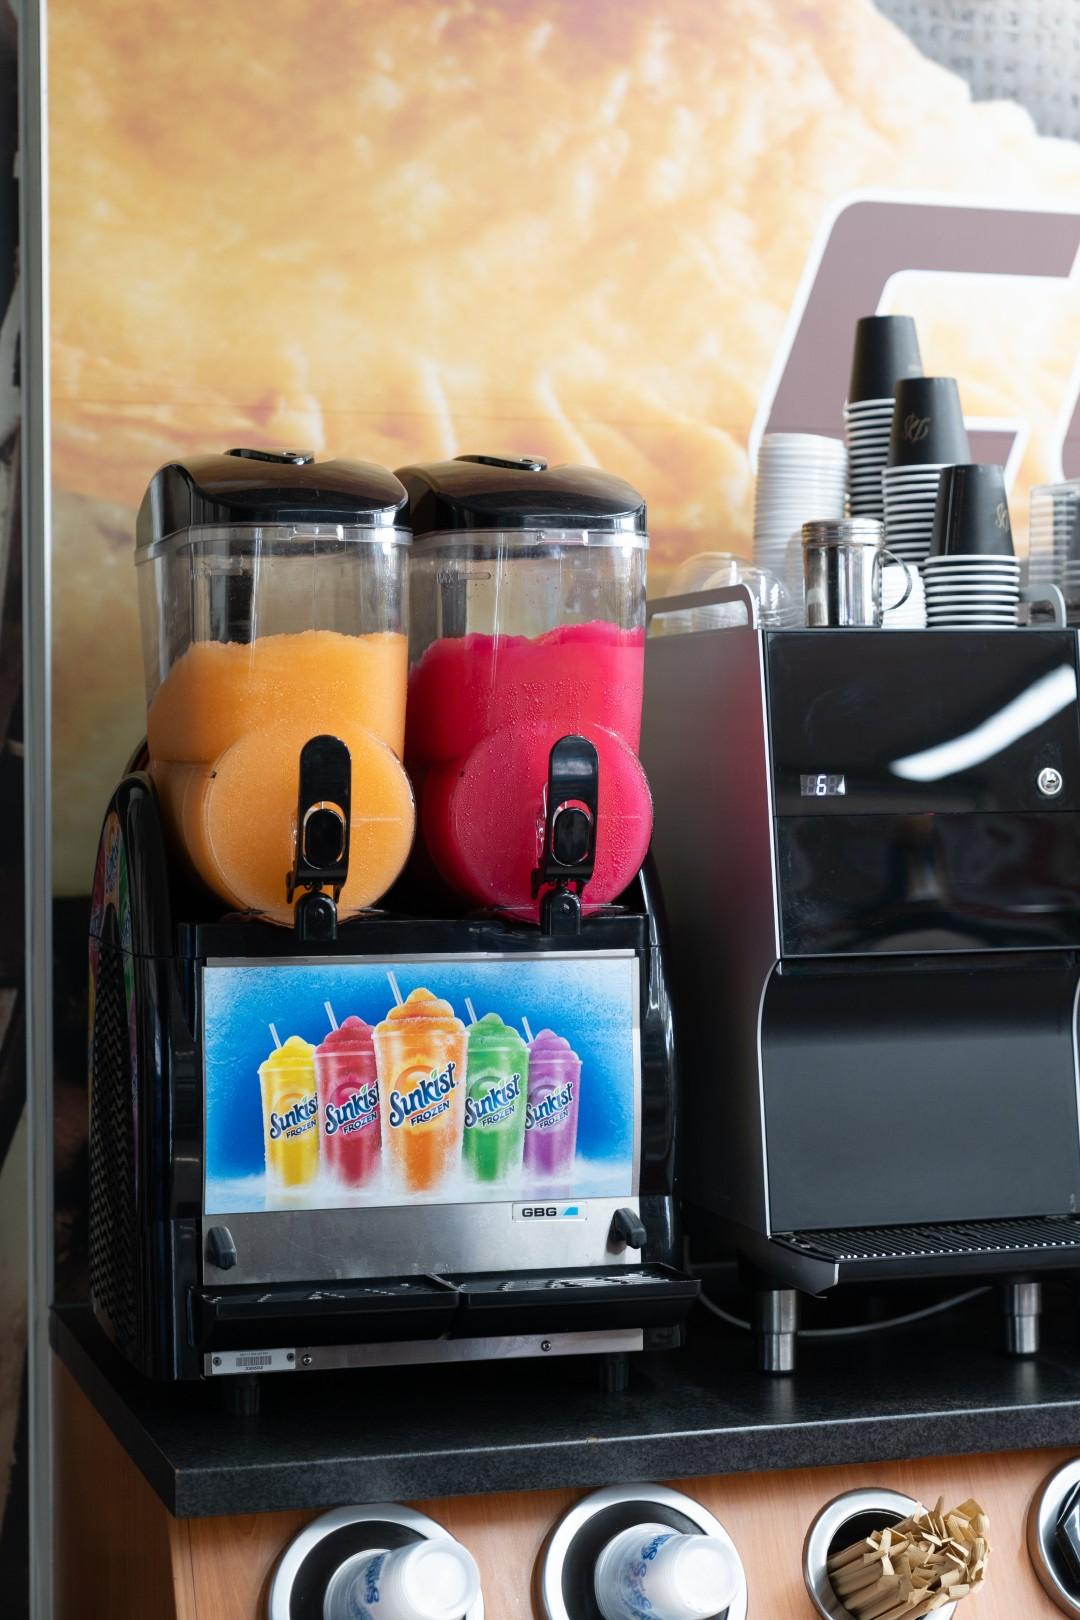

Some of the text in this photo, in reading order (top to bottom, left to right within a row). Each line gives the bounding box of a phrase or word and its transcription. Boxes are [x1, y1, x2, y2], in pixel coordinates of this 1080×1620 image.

[816, 775, 827, 796] 6
[389, 1062, 456, 1127] Sunkist
[464, 1073, 520, 1128] Sunkist
[410, 1100, 450, 1126] FROZEN
[482, 1105, 515, 1127] FROZEN
[525, 1083, 573, 1130] Sunkist
[286, 1119, 317, 1139] FROZEN
[343, 1112, 377, 1134] FROZEN
[539, 1109, 569, 1129] FROZEN
[522, 1207, 557, 1218] GBG
